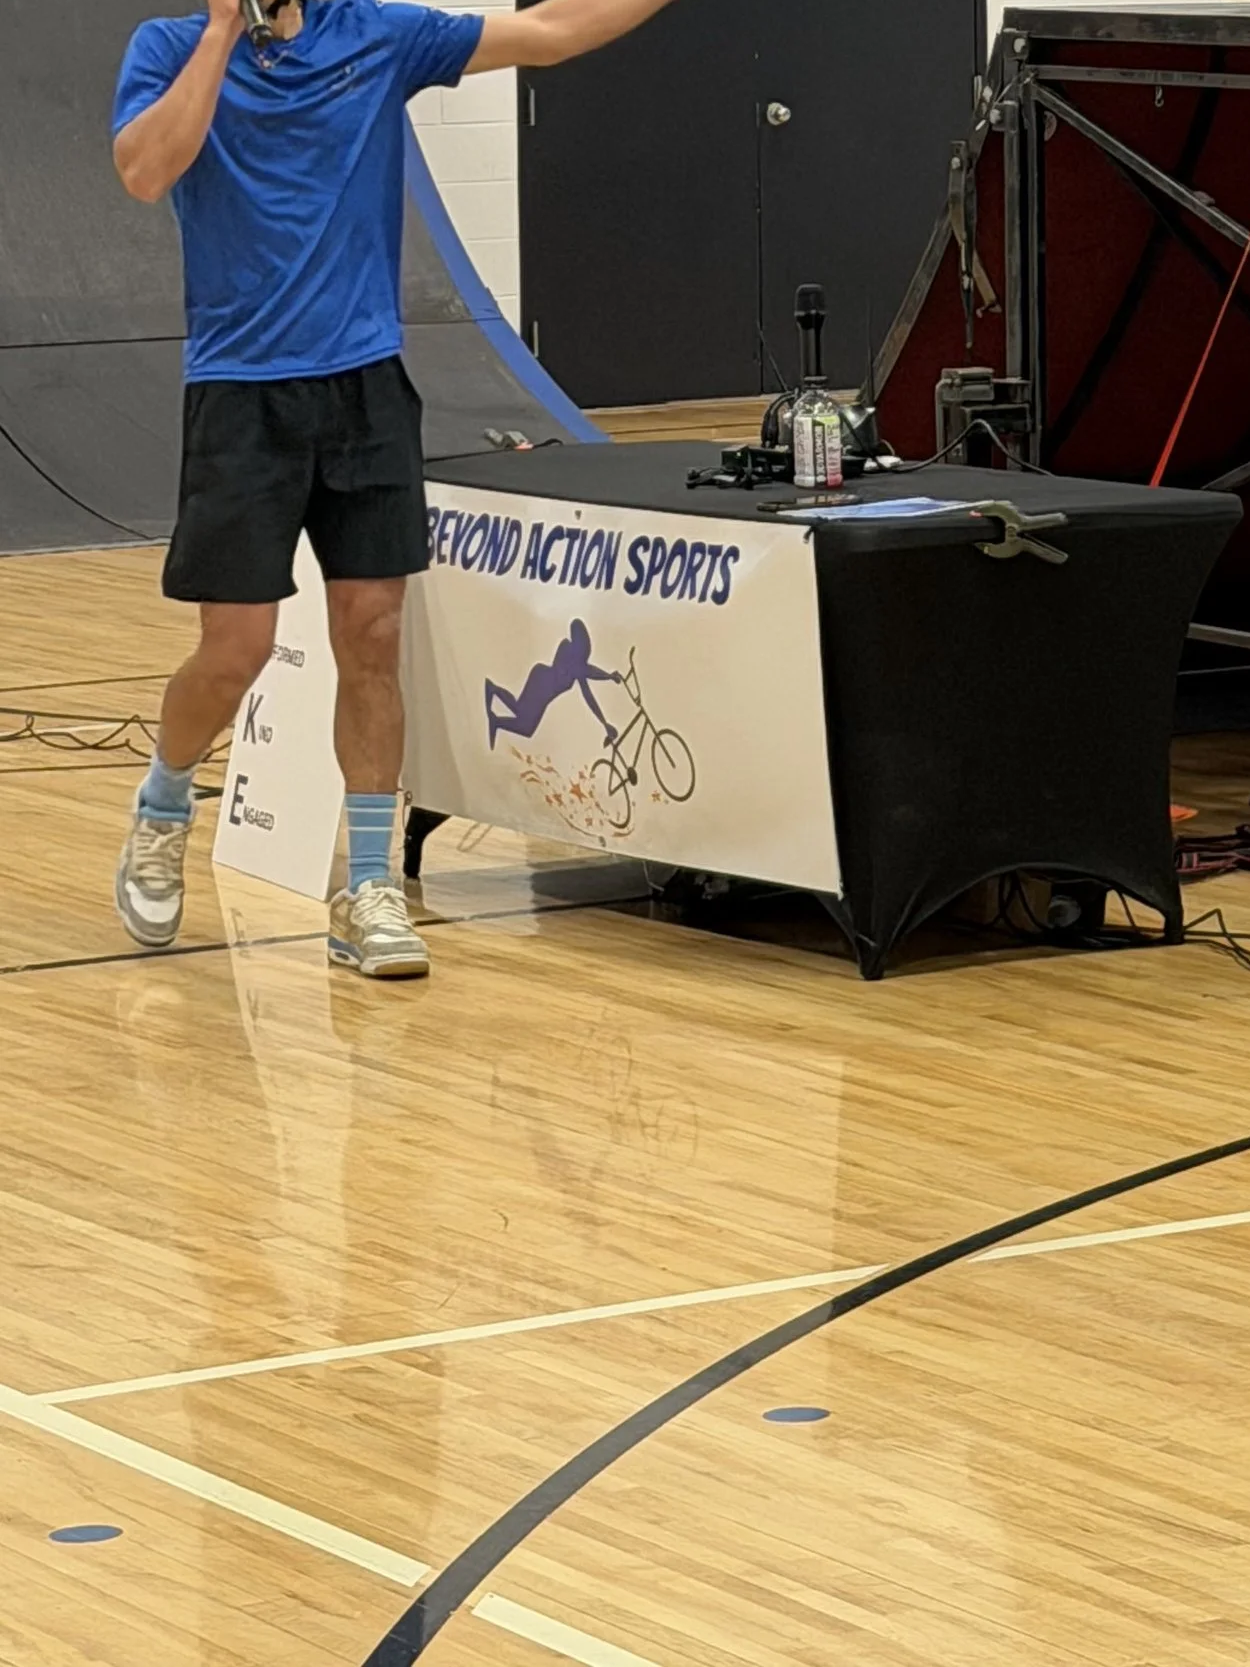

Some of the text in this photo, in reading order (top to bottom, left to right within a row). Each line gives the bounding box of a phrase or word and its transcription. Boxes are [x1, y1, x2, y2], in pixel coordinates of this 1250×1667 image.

[427, 506, 740, 606] BEYOND ACTION SPORTS
